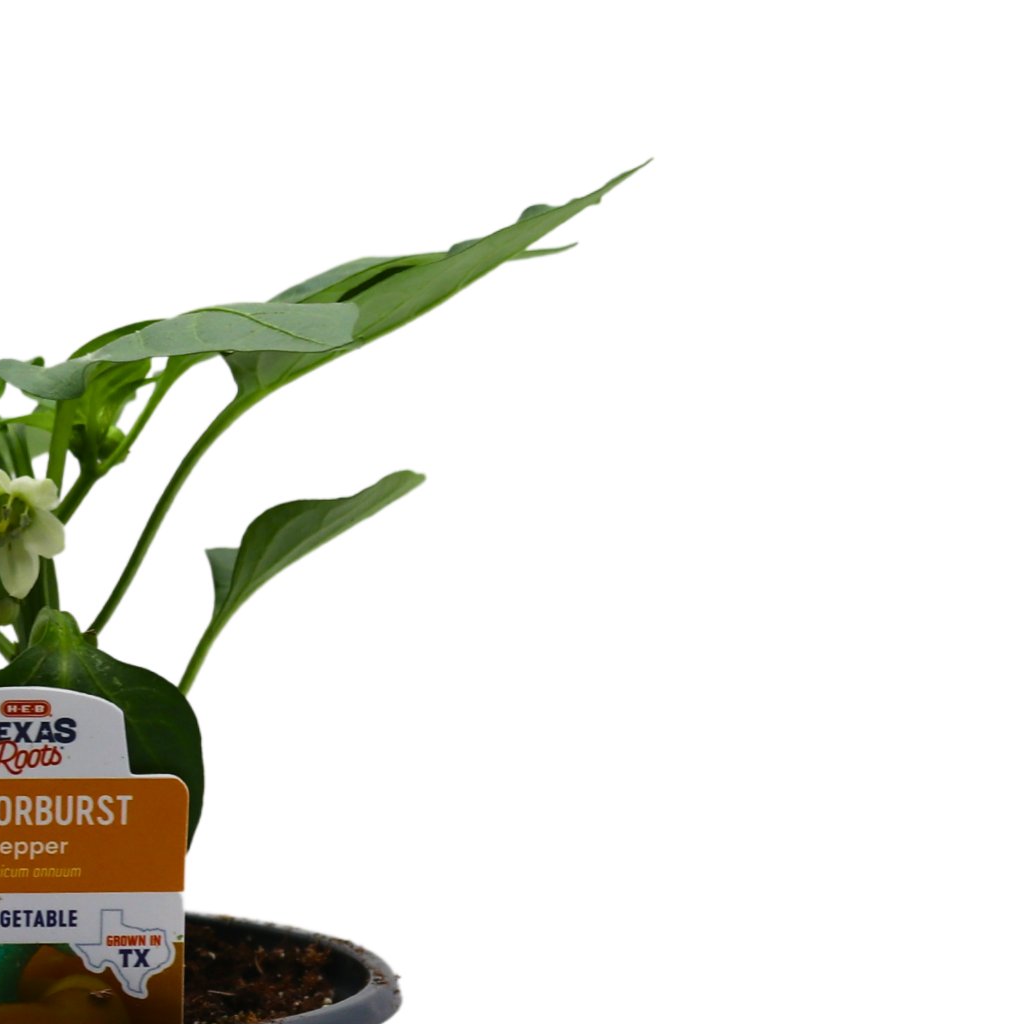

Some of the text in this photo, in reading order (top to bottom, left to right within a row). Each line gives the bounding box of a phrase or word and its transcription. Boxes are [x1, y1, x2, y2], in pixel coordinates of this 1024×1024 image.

[33, 866, 82, 879] annuum
[106, 935, 162, 947] GROWN IN
[119, 949, 150, 968] TX
